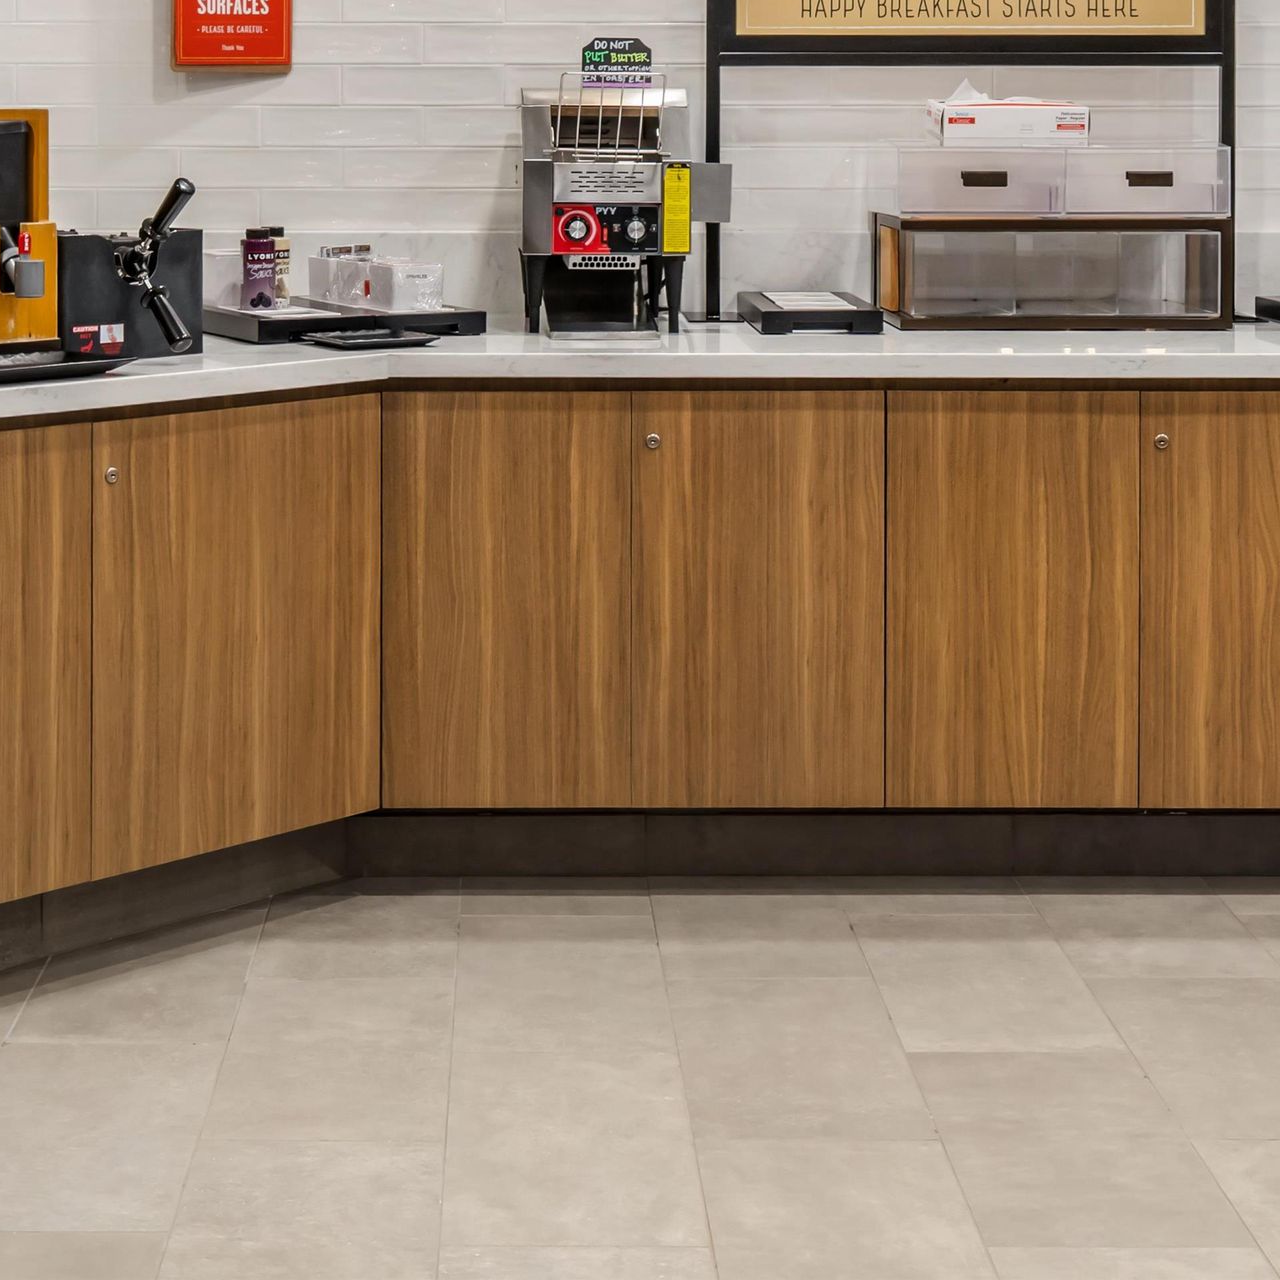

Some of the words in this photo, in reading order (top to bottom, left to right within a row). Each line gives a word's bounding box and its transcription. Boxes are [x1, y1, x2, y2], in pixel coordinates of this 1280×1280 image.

[201, 25, 224, 33] PLEASE
[227, 25, 234, 33] BE
[236, 25, 263, 33] CAREFUL
[594, 40, 608, 50] DO
[609, 40, 634, 51] NOT
[584, 50, 609, 63] PUT
[610, 52, 650, 63] BUTTER
[595, 206, 617, 215] PYY
